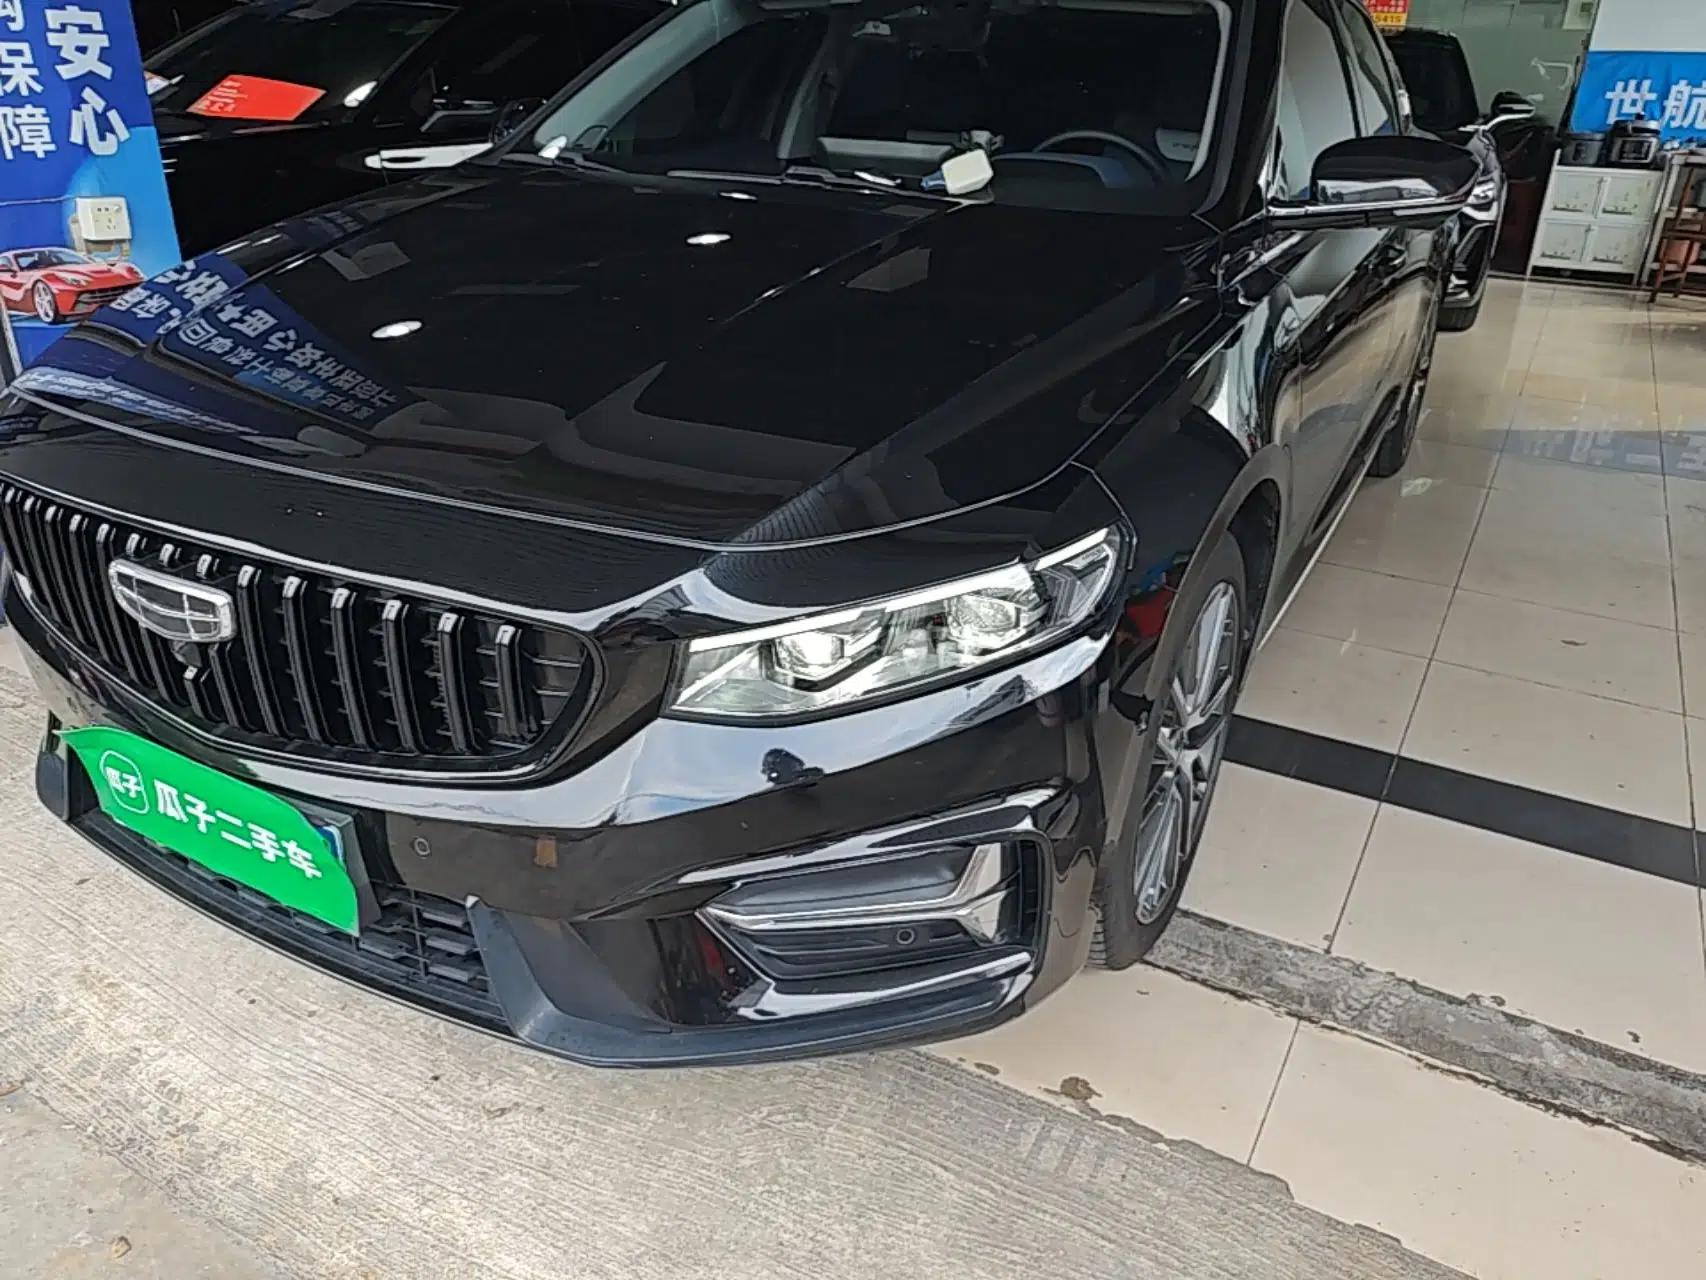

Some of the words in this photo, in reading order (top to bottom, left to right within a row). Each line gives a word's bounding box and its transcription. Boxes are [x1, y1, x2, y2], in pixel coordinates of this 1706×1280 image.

[44, 4, 131, 156] 安心
[1604, 79, 1706, 130] 世航
[105, 766, 143, 799] 瓜子
[153, 778, 322, 879] 瓜子二手车
